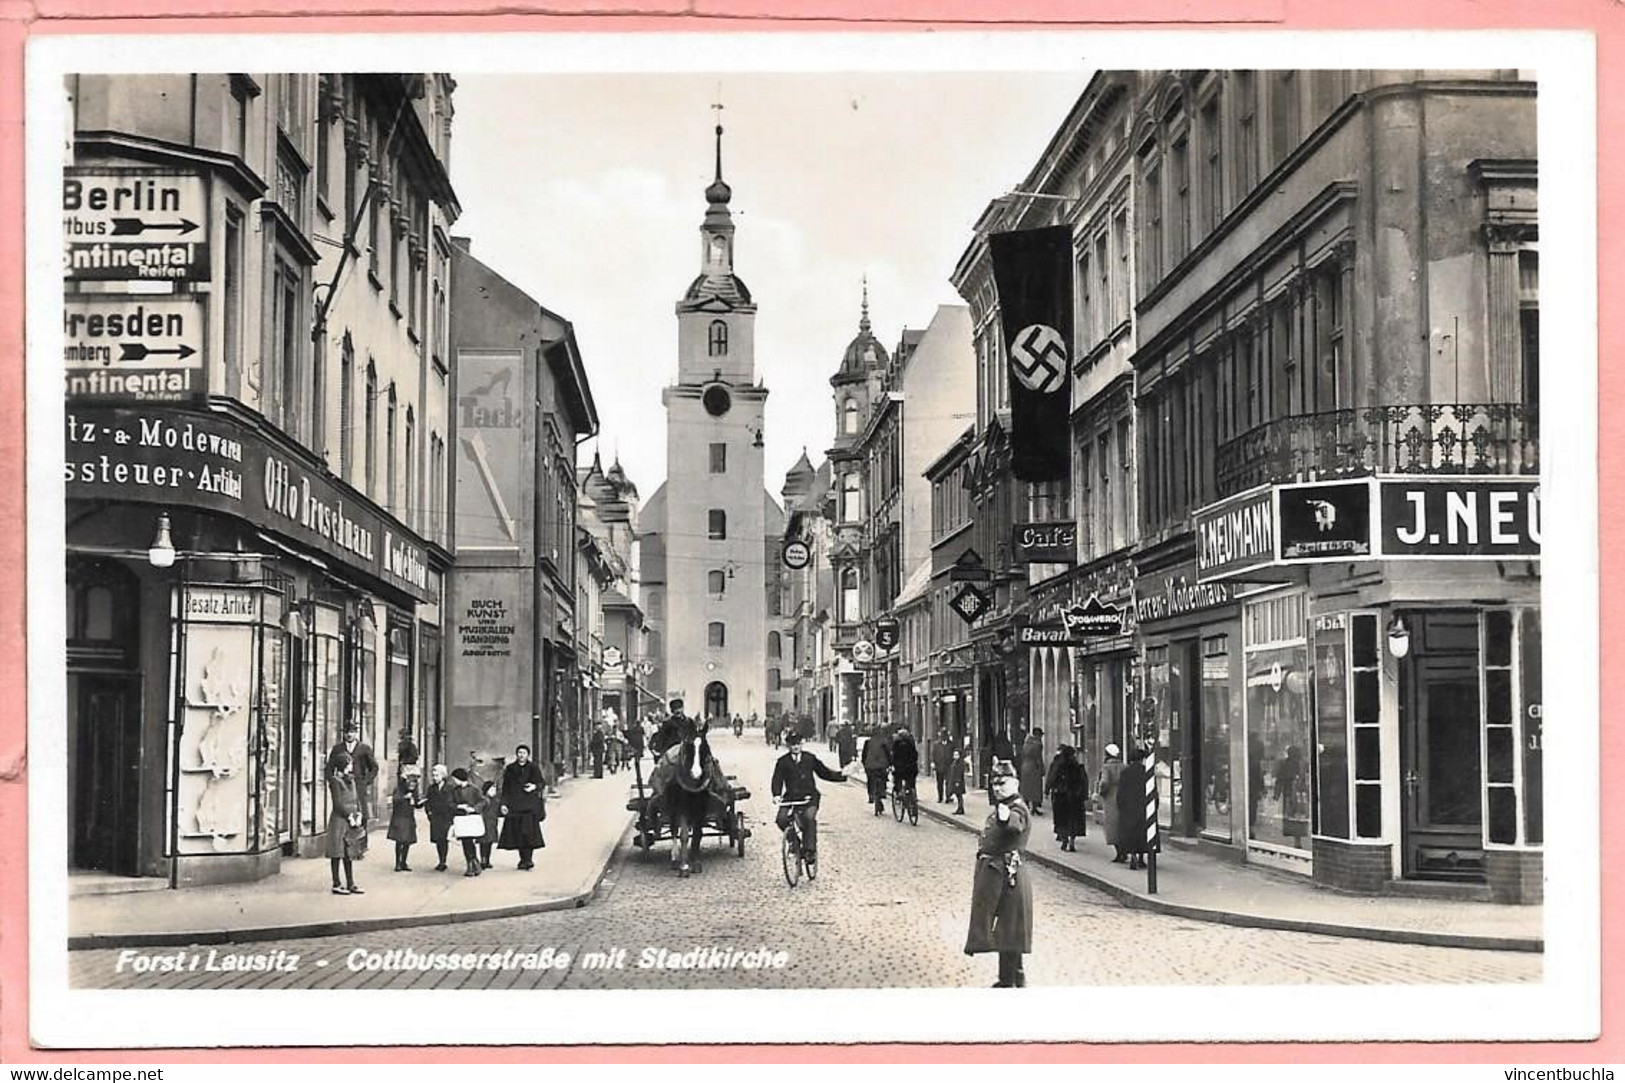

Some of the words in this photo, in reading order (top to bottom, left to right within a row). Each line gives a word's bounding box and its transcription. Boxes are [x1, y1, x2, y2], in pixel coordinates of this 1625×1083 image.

[63, 180, 180, 211] Berlin
[63, 243, 194, 275] ontinental
[138, 264, 186, 277] Reifen
[64, 306, 183, 337] resden
[64, 342, 110, 366] mberg
[139, 418, 242, 462] Modewaren
[264, 456, 298, 520] Otto
[1020, 527, 1075, 548] Café
[186, 591, 218, 615] Besatz
[467, 609, 507, 618] KUNST
[471, 600, 502, 609] BUCH
[458, 626, 515, 635] MUSIKALIEN
